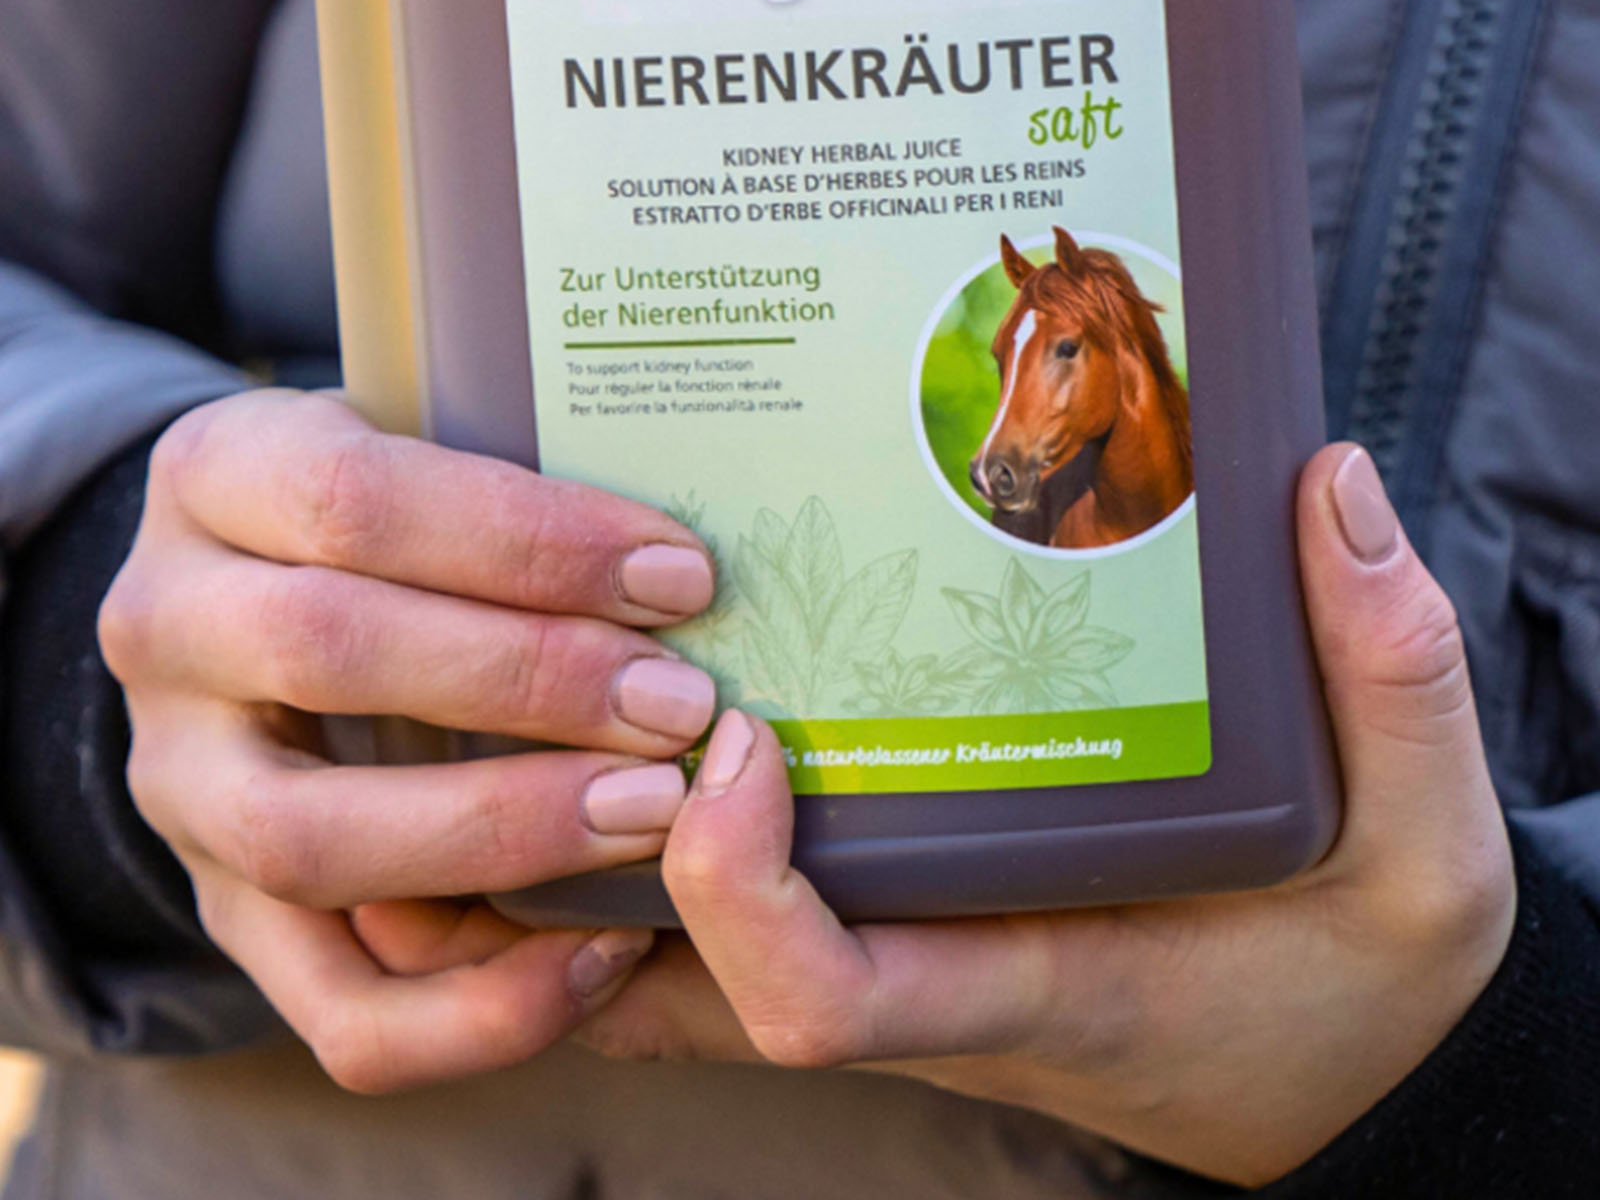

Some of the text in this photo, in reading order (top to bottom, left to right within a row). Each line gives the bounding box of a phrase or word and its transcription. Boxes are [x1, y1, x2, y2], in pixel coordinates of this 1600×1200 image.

[563, 33, 1120, 108] NIERENKRÄUTER
[1027, 90, 1123, 149] saft
[722, 138, 962, 167] KIDNEY HERBAL JUICE
[607, 177, 715, 198] SOLUTION
[721, 172, 738, 195] À
[743, 174, 798, 194] BASE
[914, 166, 975, 187] POUR
[980, 163, 1018, 183] LES
[1023, 158, 1087, 180] REINS
[632, 204, 742, 226] ESTRATTO
[828, 196, 948, 219] OFFICINALI
[953, 193, 994, 213] PER
[1000, 192, 1007, 211] I
[1012, 188, 1064, 210] RENI
[559, 264, 821, 293] Zur Unterstützung
[562, 298, 835, 328] der Nierenfunktion
[567, 357, 754, 376] To support kidney function
[568, 382, 600, 396] Pour
[658, 378, 672, 393] la
[675, 378, 735, 393] fonction
[569, 402, 592, 416] Per
[596, 400, 651, 416] favorire
[655, 399, 668, 414] la
[759, 398, 804, 412] renale
[802, 745, 951, 767] naturbelassener
[955, 736, 1125, 764] Kräutermischung
